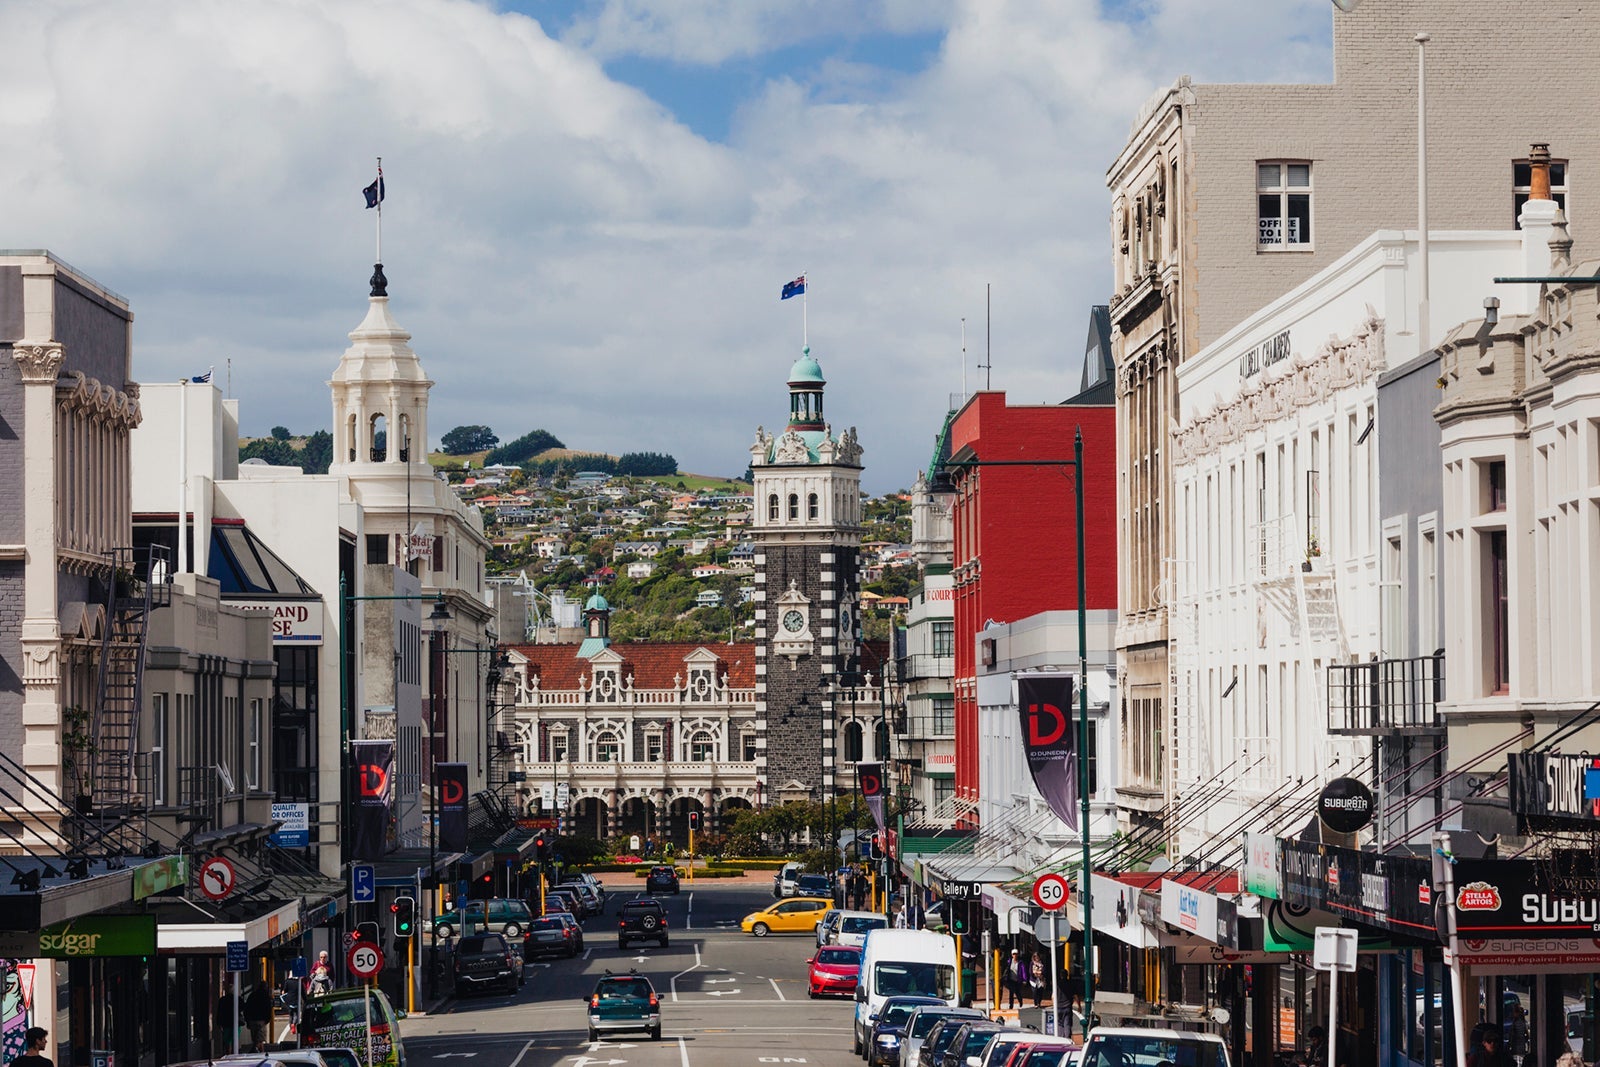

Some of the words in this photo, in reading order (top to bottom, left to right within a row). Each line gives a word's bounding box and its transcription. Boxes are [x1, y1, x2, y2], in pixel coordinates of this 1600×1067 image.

[1259, 219, 1297, 228] OFFIE
[1260, 229, 1274, 237] TO
[1277, 229, 1297, 237] LT
[1546, 756, 1582, 815] STUART
[1324, 797, 1368, 809] SUBURBIA
[358, 870, 369, 882] P
[943, 882, 969, 900] Gallery
[1042, 885, 1062, 899] 50
[40, 929, 101, 955] sugar
[1491, 941, 1579, 951] SURGEONS
[356, 953, 376, 968] 50
[1478, 956, 1516, 964] Leading
[1517, 955, 1557, 964] Repairer
[321, 1032, 342, 1041] THEY
